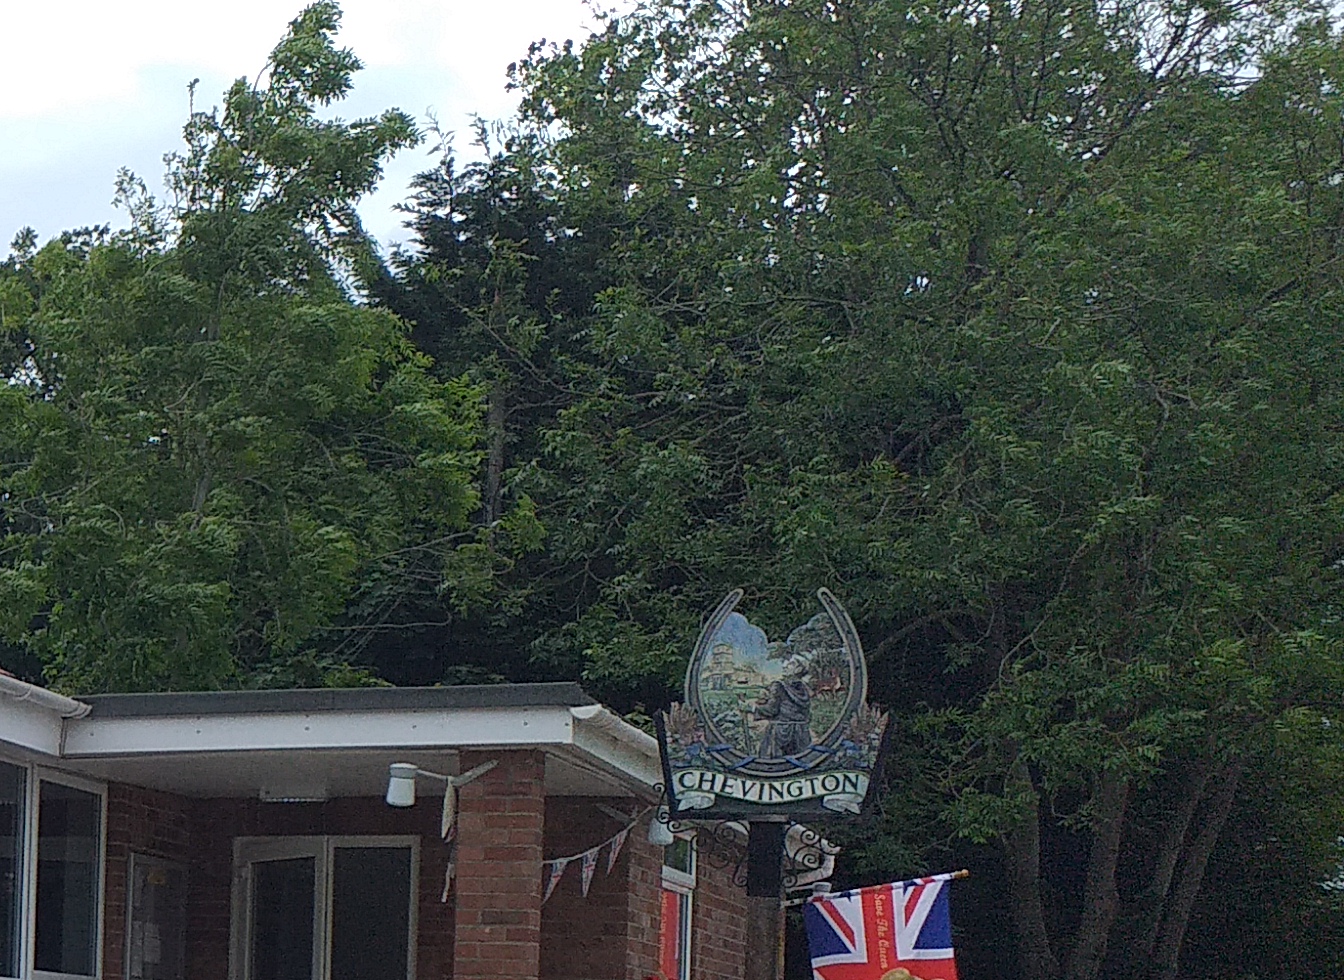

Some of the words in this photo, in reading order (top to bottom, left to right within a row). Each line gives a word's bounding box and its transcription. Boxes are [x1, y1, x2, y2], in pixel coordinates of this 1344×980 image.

[678, 771, 859, 800] CHEVINGTON
[874, 894, 886, 917] Save
[877, 918, 889, 938] The
